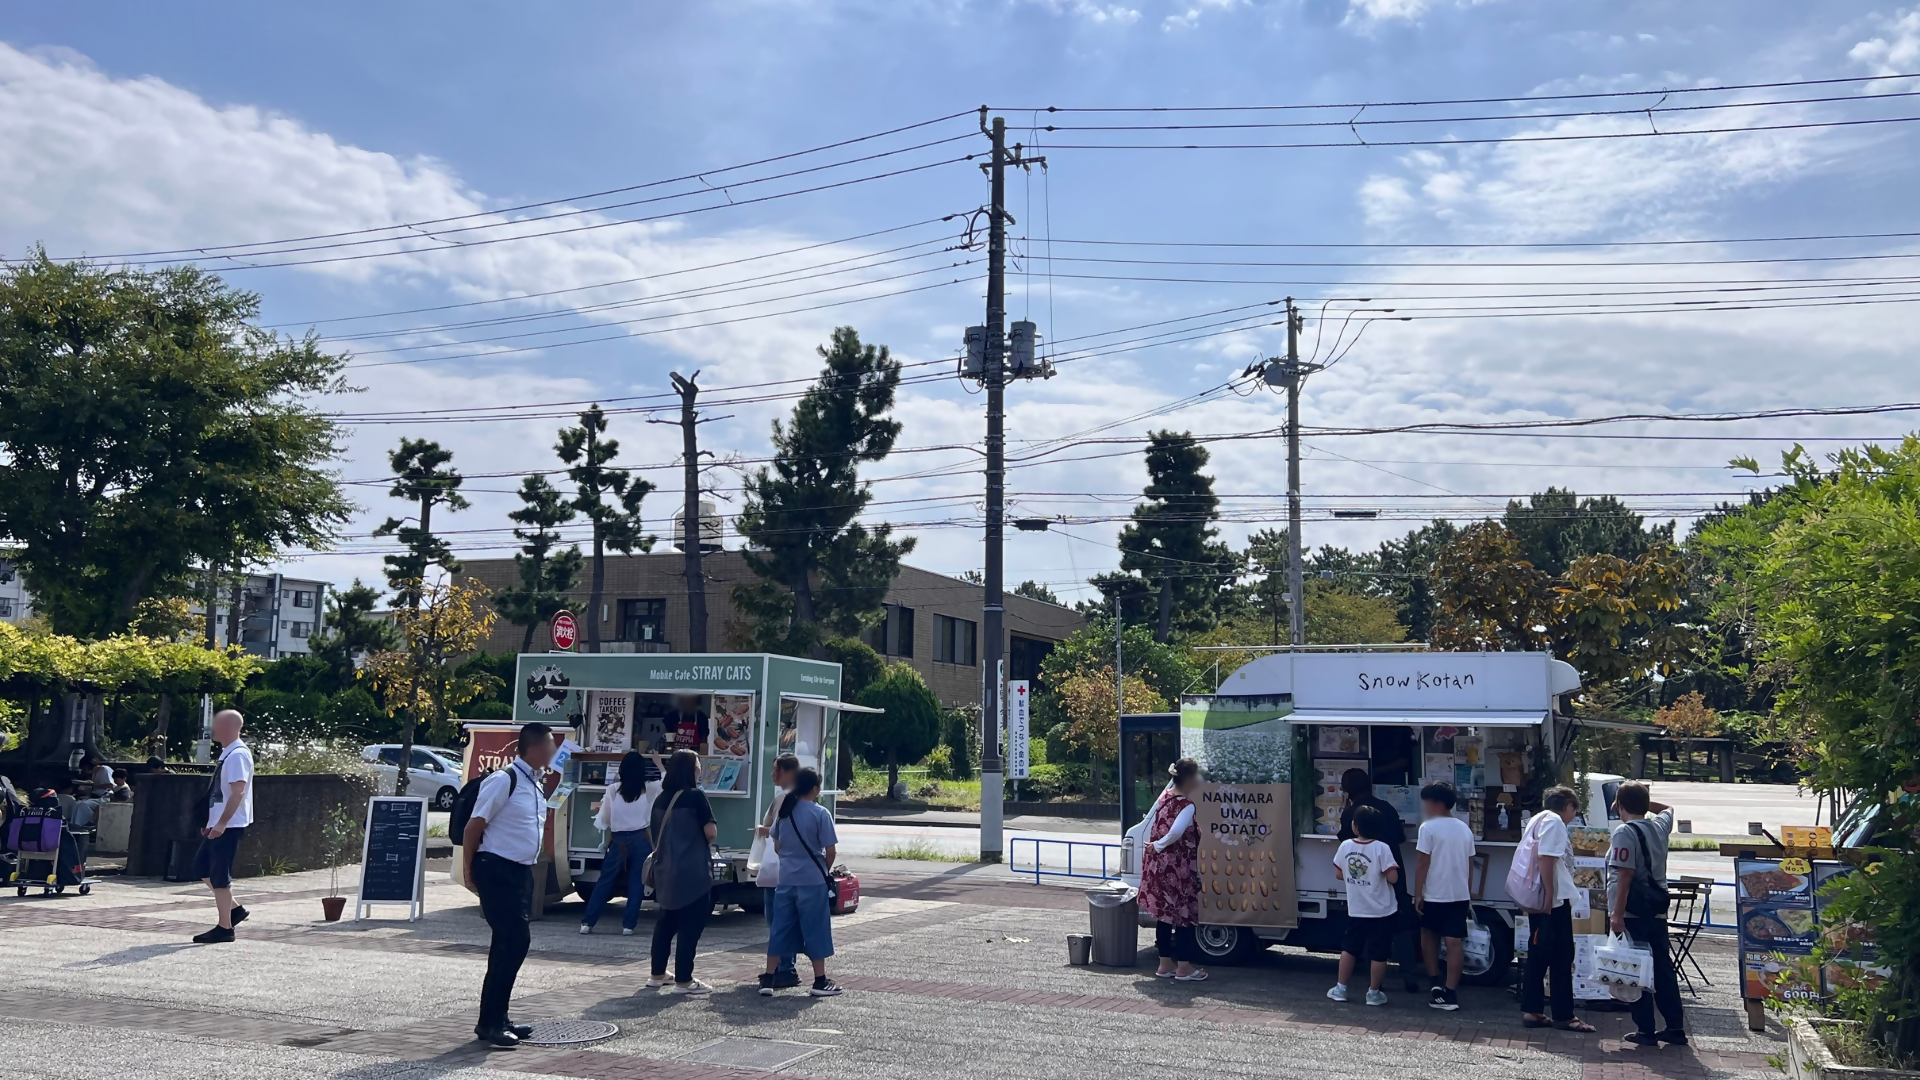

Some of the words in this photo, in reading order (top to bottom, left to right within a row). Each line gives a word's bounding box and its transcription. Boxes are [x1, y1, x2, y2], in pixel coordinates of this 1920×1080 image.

[556, 625, 574, 640] 消火栓
[650, 669, 672, 680] Mobile
[674, 669, 690, 681] Cafe
[692, 665, 723, 680] STRAY
[726, 666, 751, 681] CATS
[1358, 672, 1410, 691] Snow
[1416, 671, 1475, 690] Kotan
[599, 697, 626, 706] COFFEE
[478, 754, 515, 773] STRA
[1202, 791, 1274, 804] NANMARA
[1220, 807, 1258, 820] UMAI
[1210, 822, 1267, 836] POTATO
[1613, 847, 1629, 863] 10
[1783, 990, 1820, 1000] 600円
